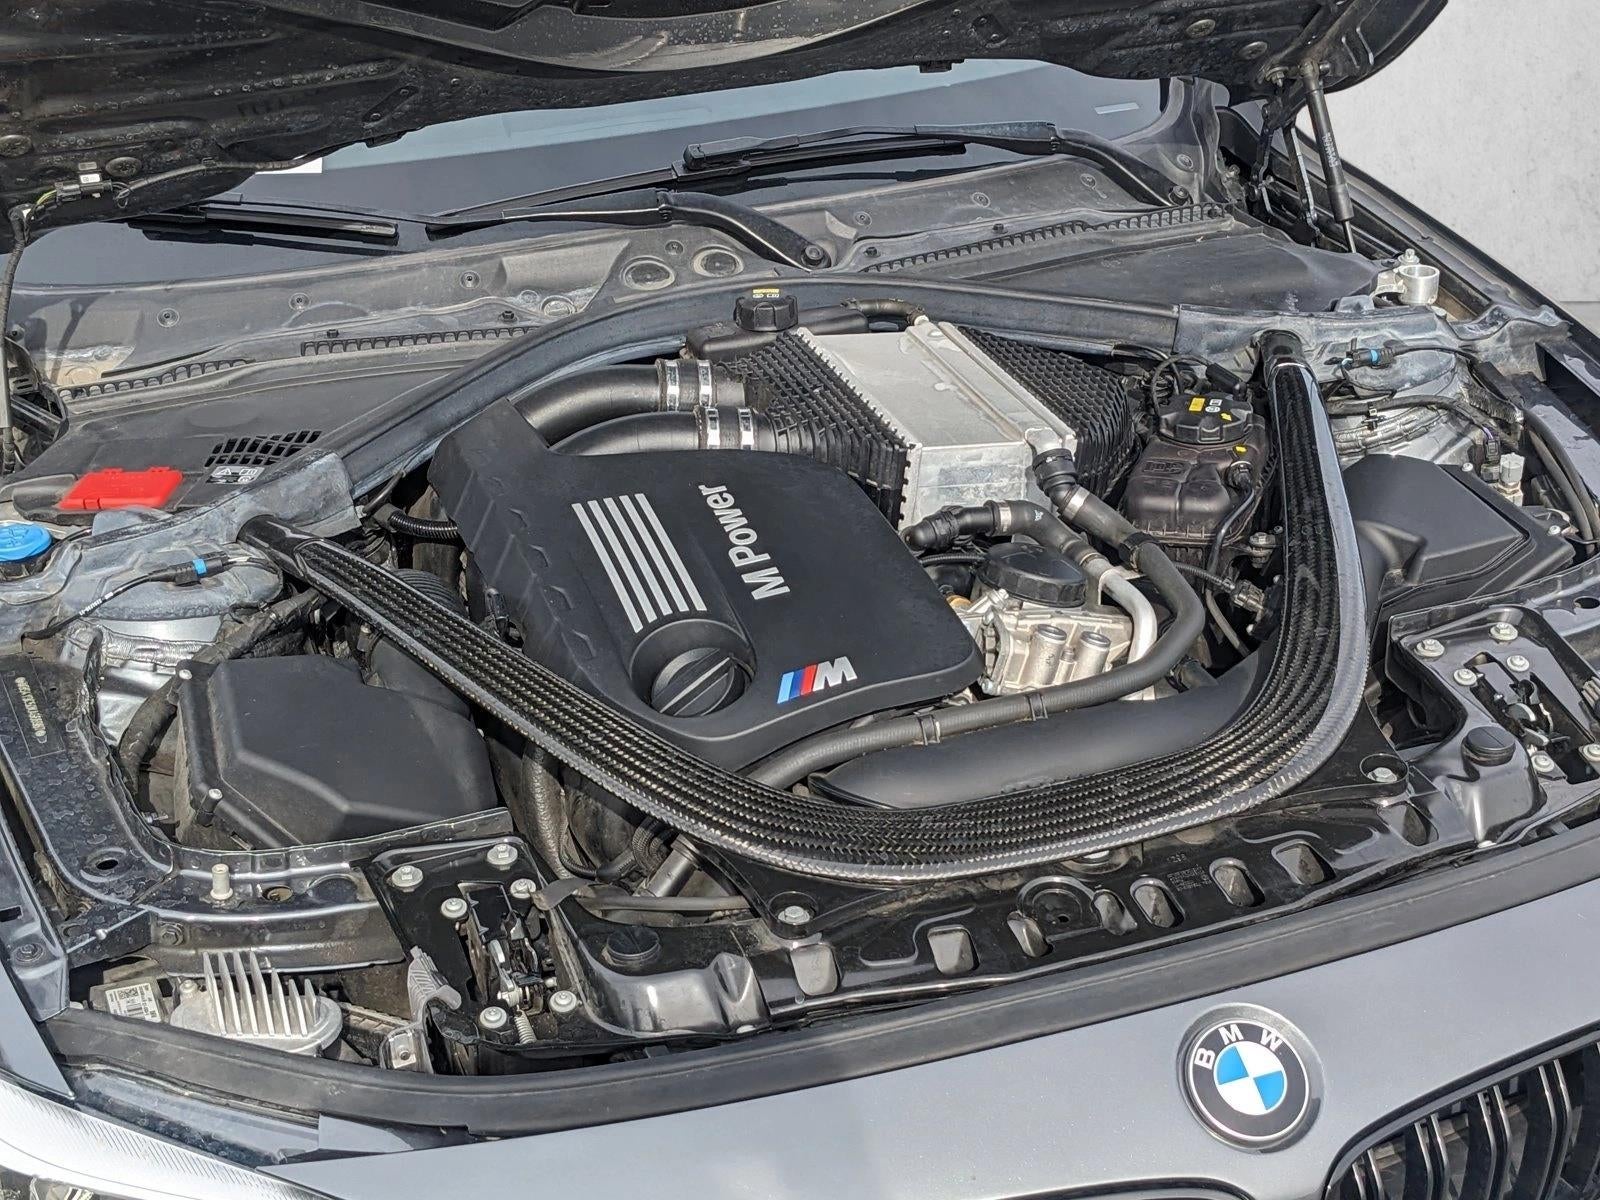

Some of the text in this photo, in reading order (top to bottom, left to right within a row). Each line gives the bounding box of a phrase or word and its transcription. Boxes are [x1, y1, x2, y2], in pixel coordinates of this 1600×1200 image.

[698, 484, 791, 600] M Power
[1194, 1023, 1284, 1070] BMW
